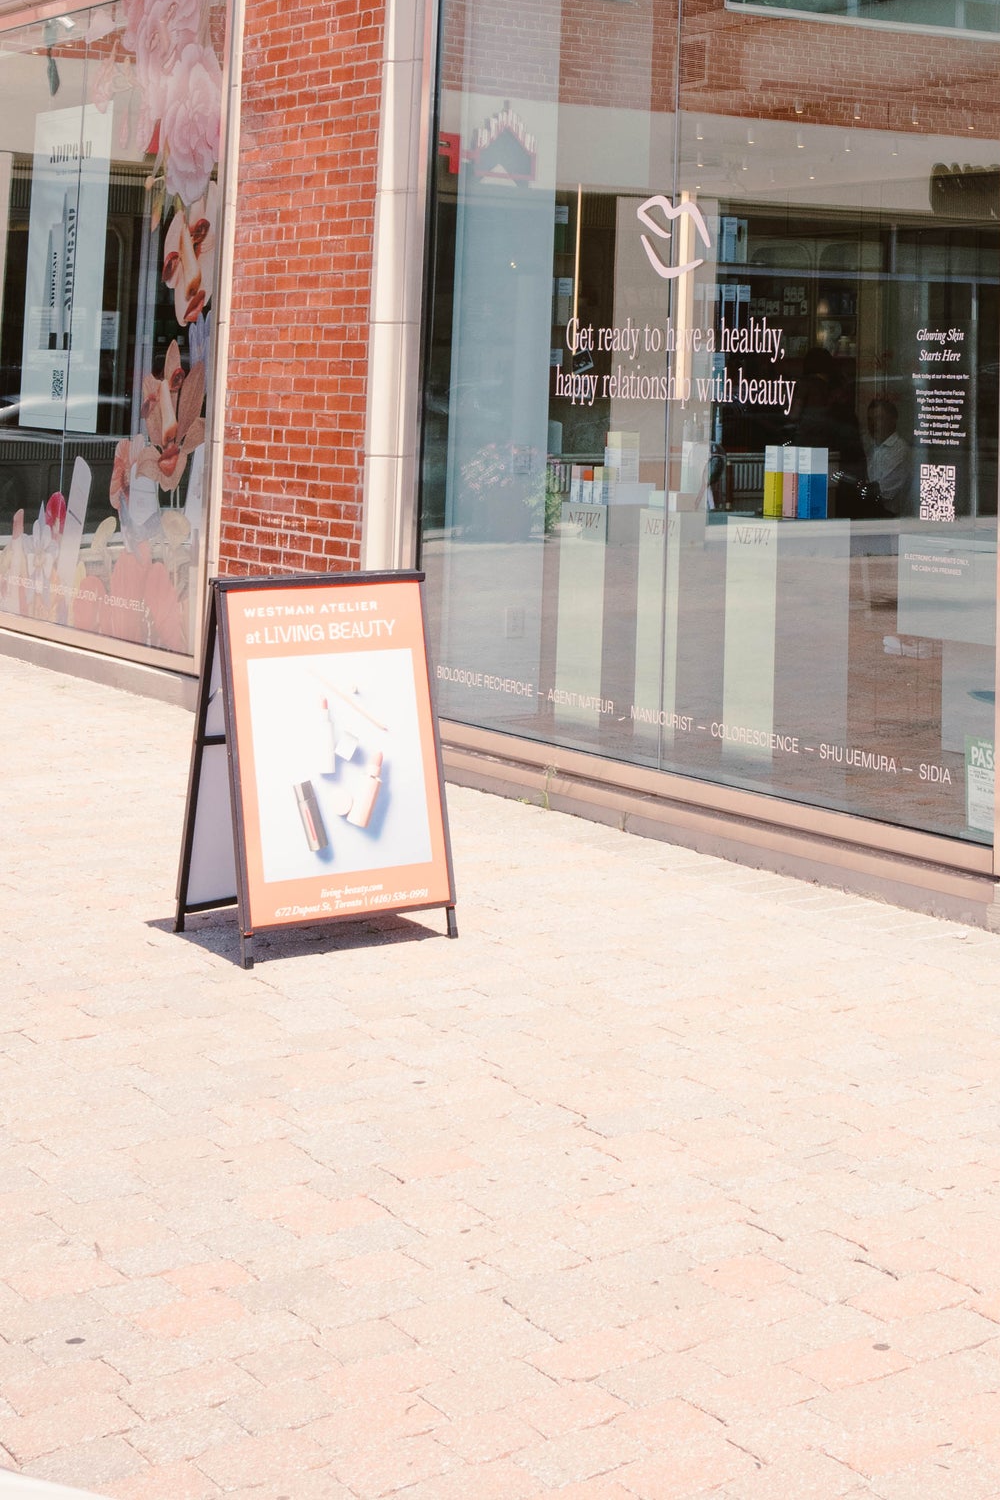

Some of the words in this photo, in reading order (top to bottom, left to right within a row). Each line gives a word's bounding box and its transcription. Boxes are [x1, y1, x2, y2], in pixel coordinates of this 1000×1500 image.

[566, 317, 594, 351] Get
[598, 317, 639, 359] ready
[644, 322, 660, 352] to
[706, 334, 715, 352] a
[721, 317, 785, 363] healthy,
[917, 328, 947, 345] Glowing
[947, 328, 964, 343] Skin
[919, 349, 941, 361] Starts
[942, 349, 961, 361] Here
[555, 364, 598, 406] happy
[696, 366, 733, 403] with
[738, 367, 796, 415] beauty
[568, 511, 600, 529] NEW!
[644, 518, 675, 537] NEW!
[733, 526, 770, 546] NEW!
[243, 605, 314, 618] WESTMAN
[320, 601, 377, 614] ATELIER
[246, 631, 262, 644] at
[264, 624, 324, 644] LIVING
[328, 619, 395, 640] BEAUTY
[437, 666, 483, 687] BIOLOGIQUE
[484, 674, 533, 698] RECHERCHE
[547, 688, 576, 705] AGENT
[578, 692, 613, 715] NATEUR
[630, 705, 693, 732] MANUCURIST
[711, 722, 799, 754] COLORESCIENCE
[819, 744, 842, 762] SHU
[845, 748, 896, 774] UEMURA
[919, 764, 952, 784] SIDIA
[971, 746, 995, 770] PAS
[320, 884, 383, 898] living-beauty.com
